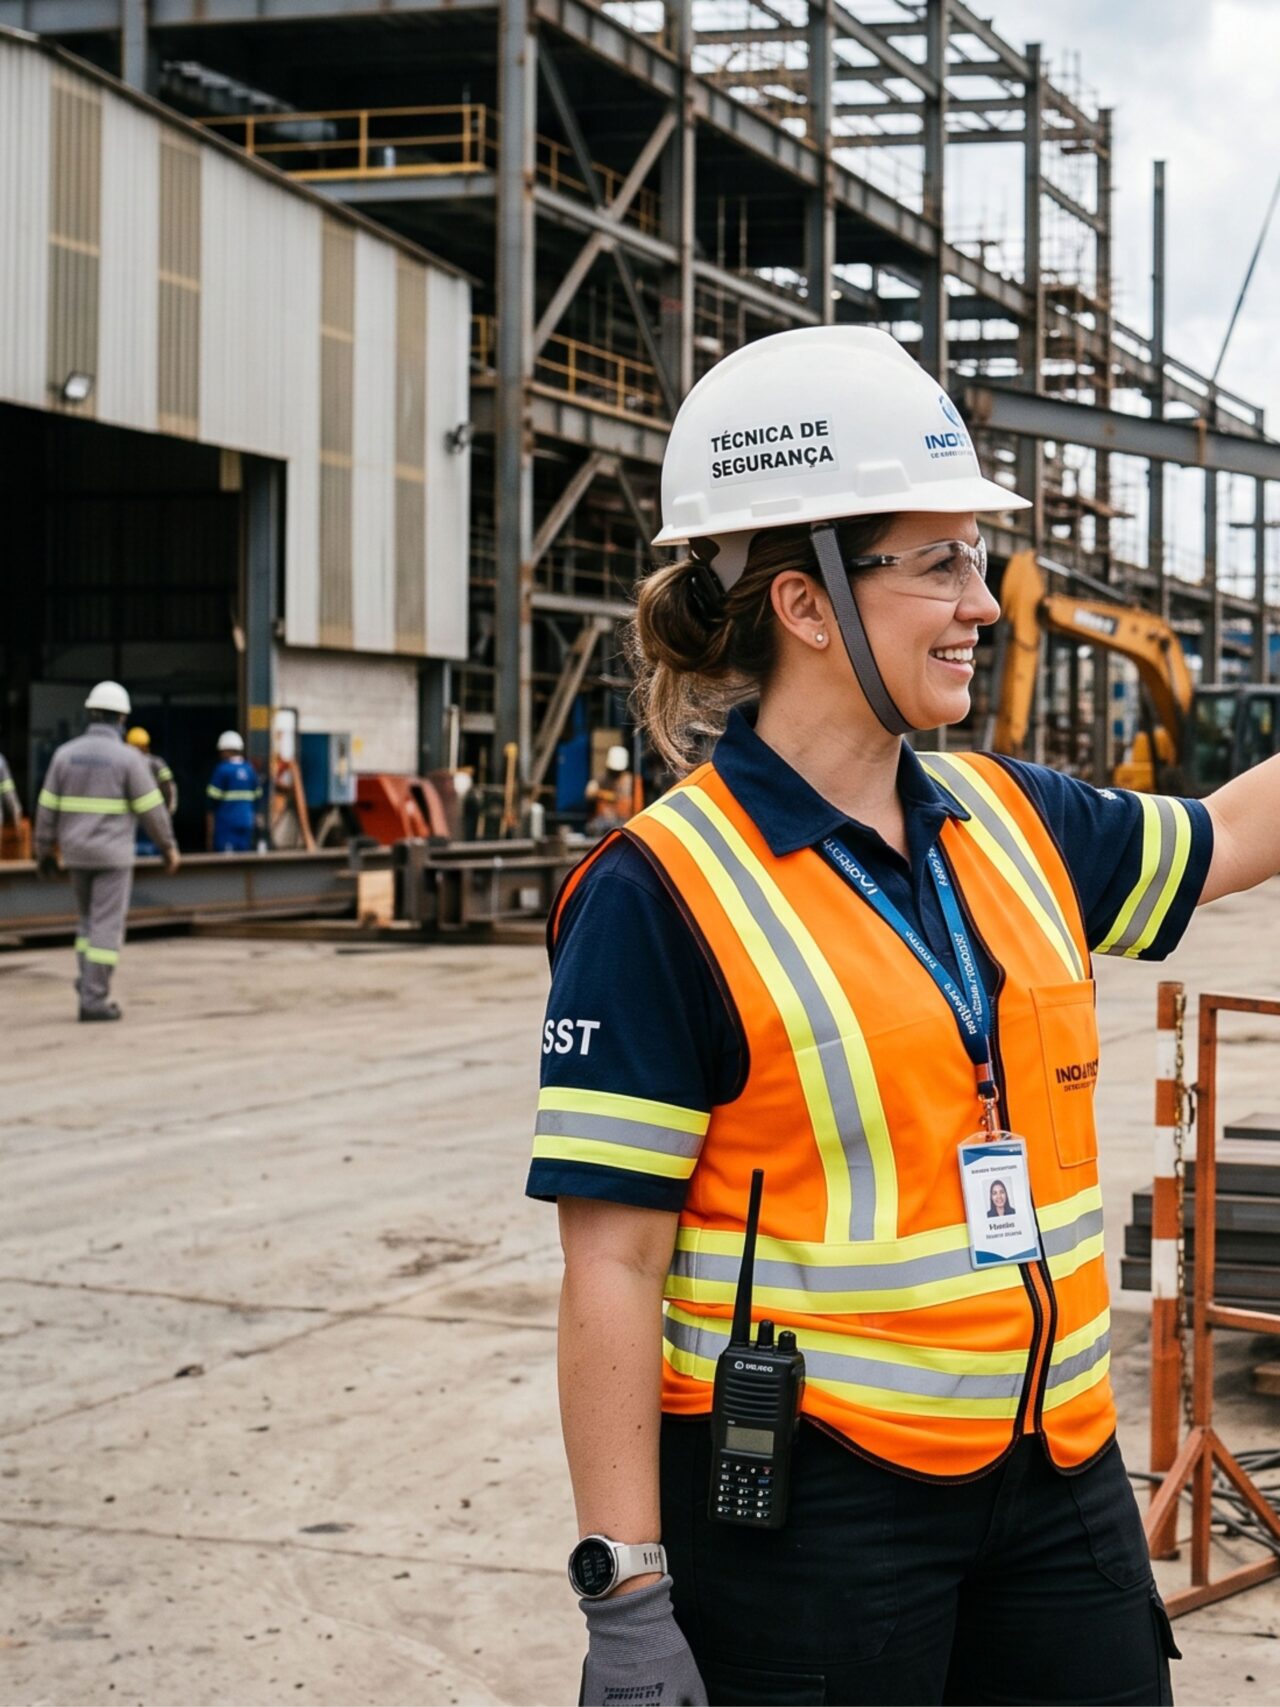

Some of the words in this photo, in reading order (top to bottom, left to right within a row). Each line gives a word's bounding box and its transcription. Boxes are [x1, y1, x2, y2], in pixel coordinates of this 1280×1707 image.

[711, 424, 794, 453] TÉCNICA
[800, 420, 829, 439] DE
[711, 445, 834, 479] SEGURANÇA
[543, 1018, 600, 1055] SST
